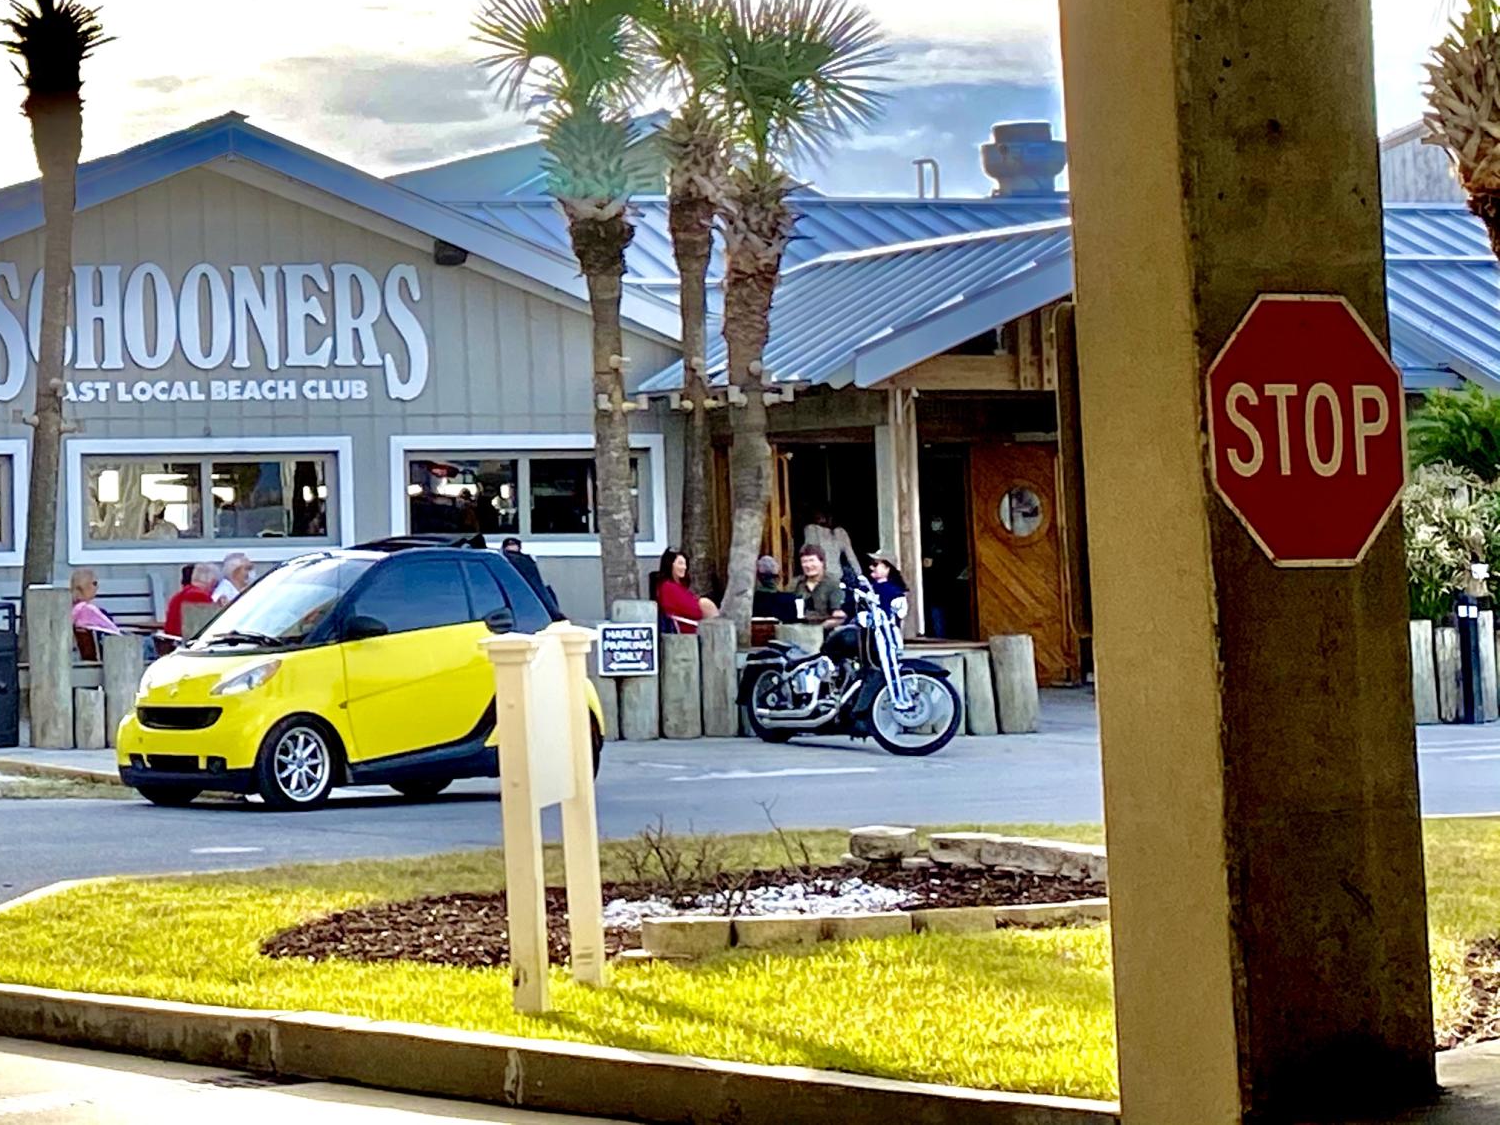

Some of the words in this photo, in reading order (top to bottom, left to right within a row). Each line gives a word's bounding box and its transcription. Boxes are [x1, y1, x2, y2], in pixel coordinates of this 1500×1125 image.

[61, 380, 111, 402] AST
[116, 380, 206, 402] LOCAL
[210, 379, 297, 401] BEACH
[302, 378, 369, 400] CLUB
[1225, 382, 1390, 477] STOP
[605, 629, 649, 640] HARLEY
[603, 640, 653, 651] PARKING
[613, 651, 644, 662] ONLY
